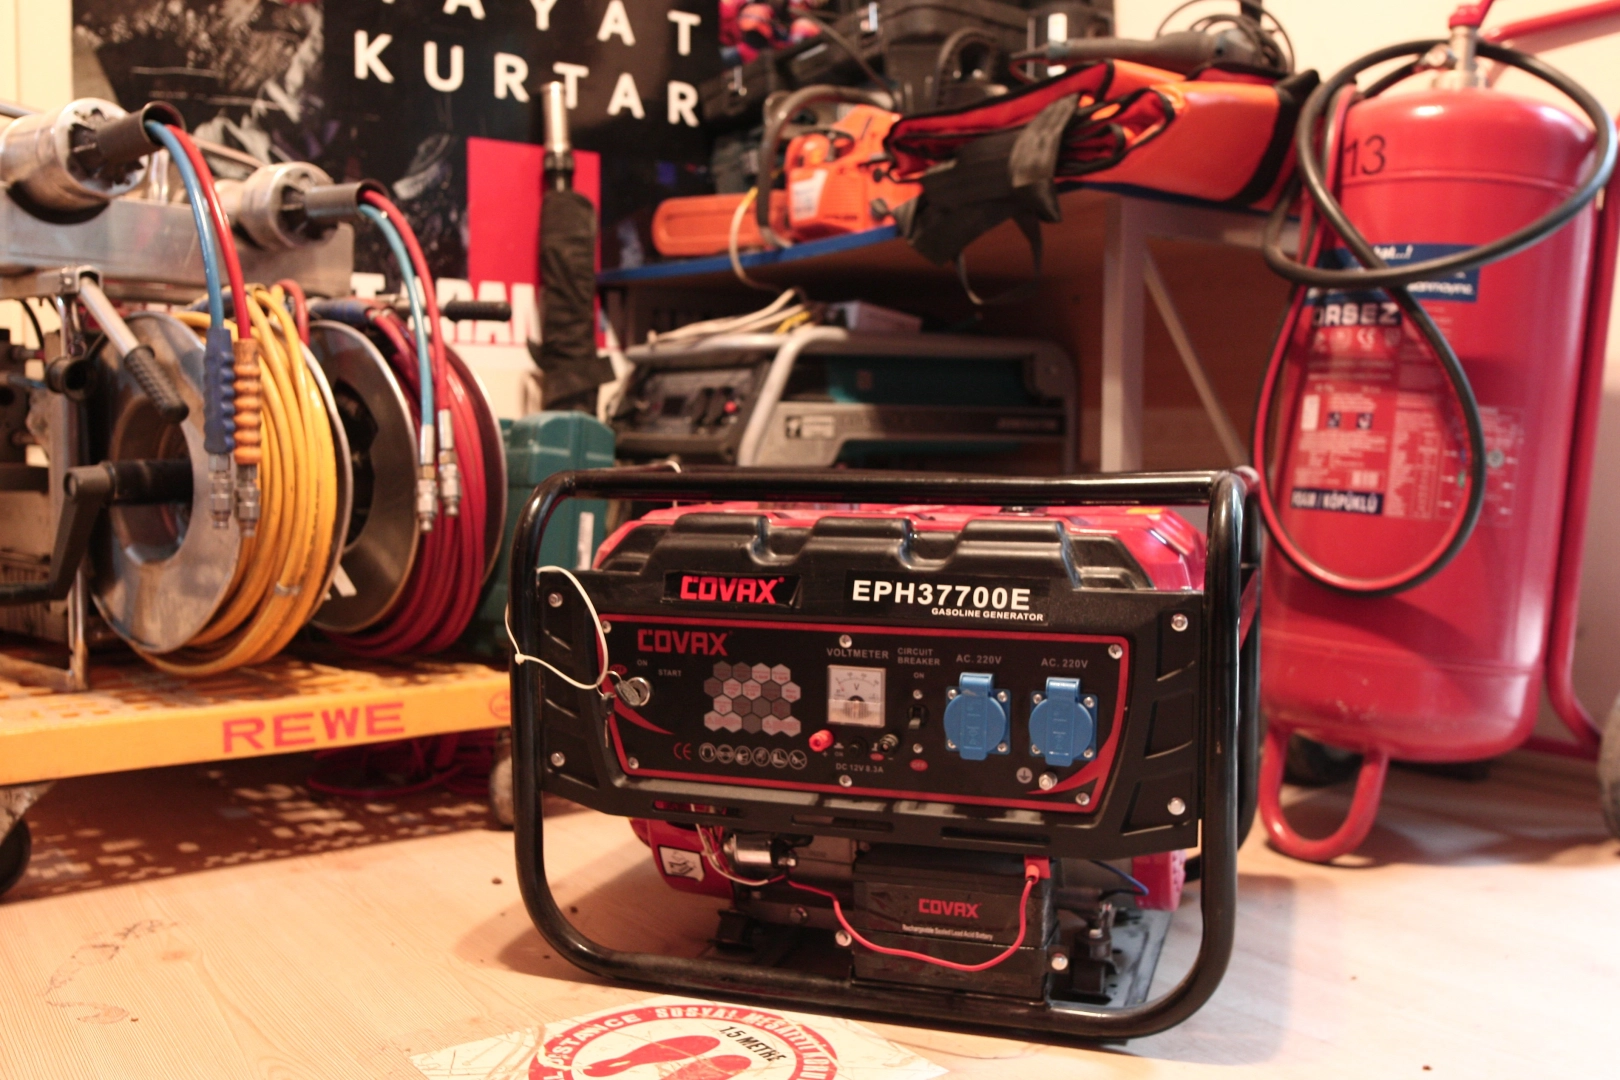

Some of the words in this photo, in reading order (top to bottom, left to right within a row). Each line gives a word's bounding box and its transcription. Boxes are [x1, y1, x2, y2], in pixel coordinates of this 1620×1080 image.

[353, 29, 700, 128] KURTAR
[680, 575, 778, 604] COVAX
[852, 579, 1031, 611] EPH37700E
[931, 607, 981, 619] GASOLINE
[982, 610, 1044, 622] GENERATOR
[637, 628, 729, 656] COVAX
[826, 647, 890, 660] VOLTMETER
[897, 647, 934, 656] CIRCUIT
[897, 656, 940, 666] BREAKER
[977, 654, 1002, 665] 220V
[1062, 658, 1089, 669] 220V
[658, 668, 682, 677] START
[913, 671, 925, 679] ON
[221, 701, 406, 755] REWE
[835, 762, 848, 771] DC
[918, 898, 980, 918] COVAX
